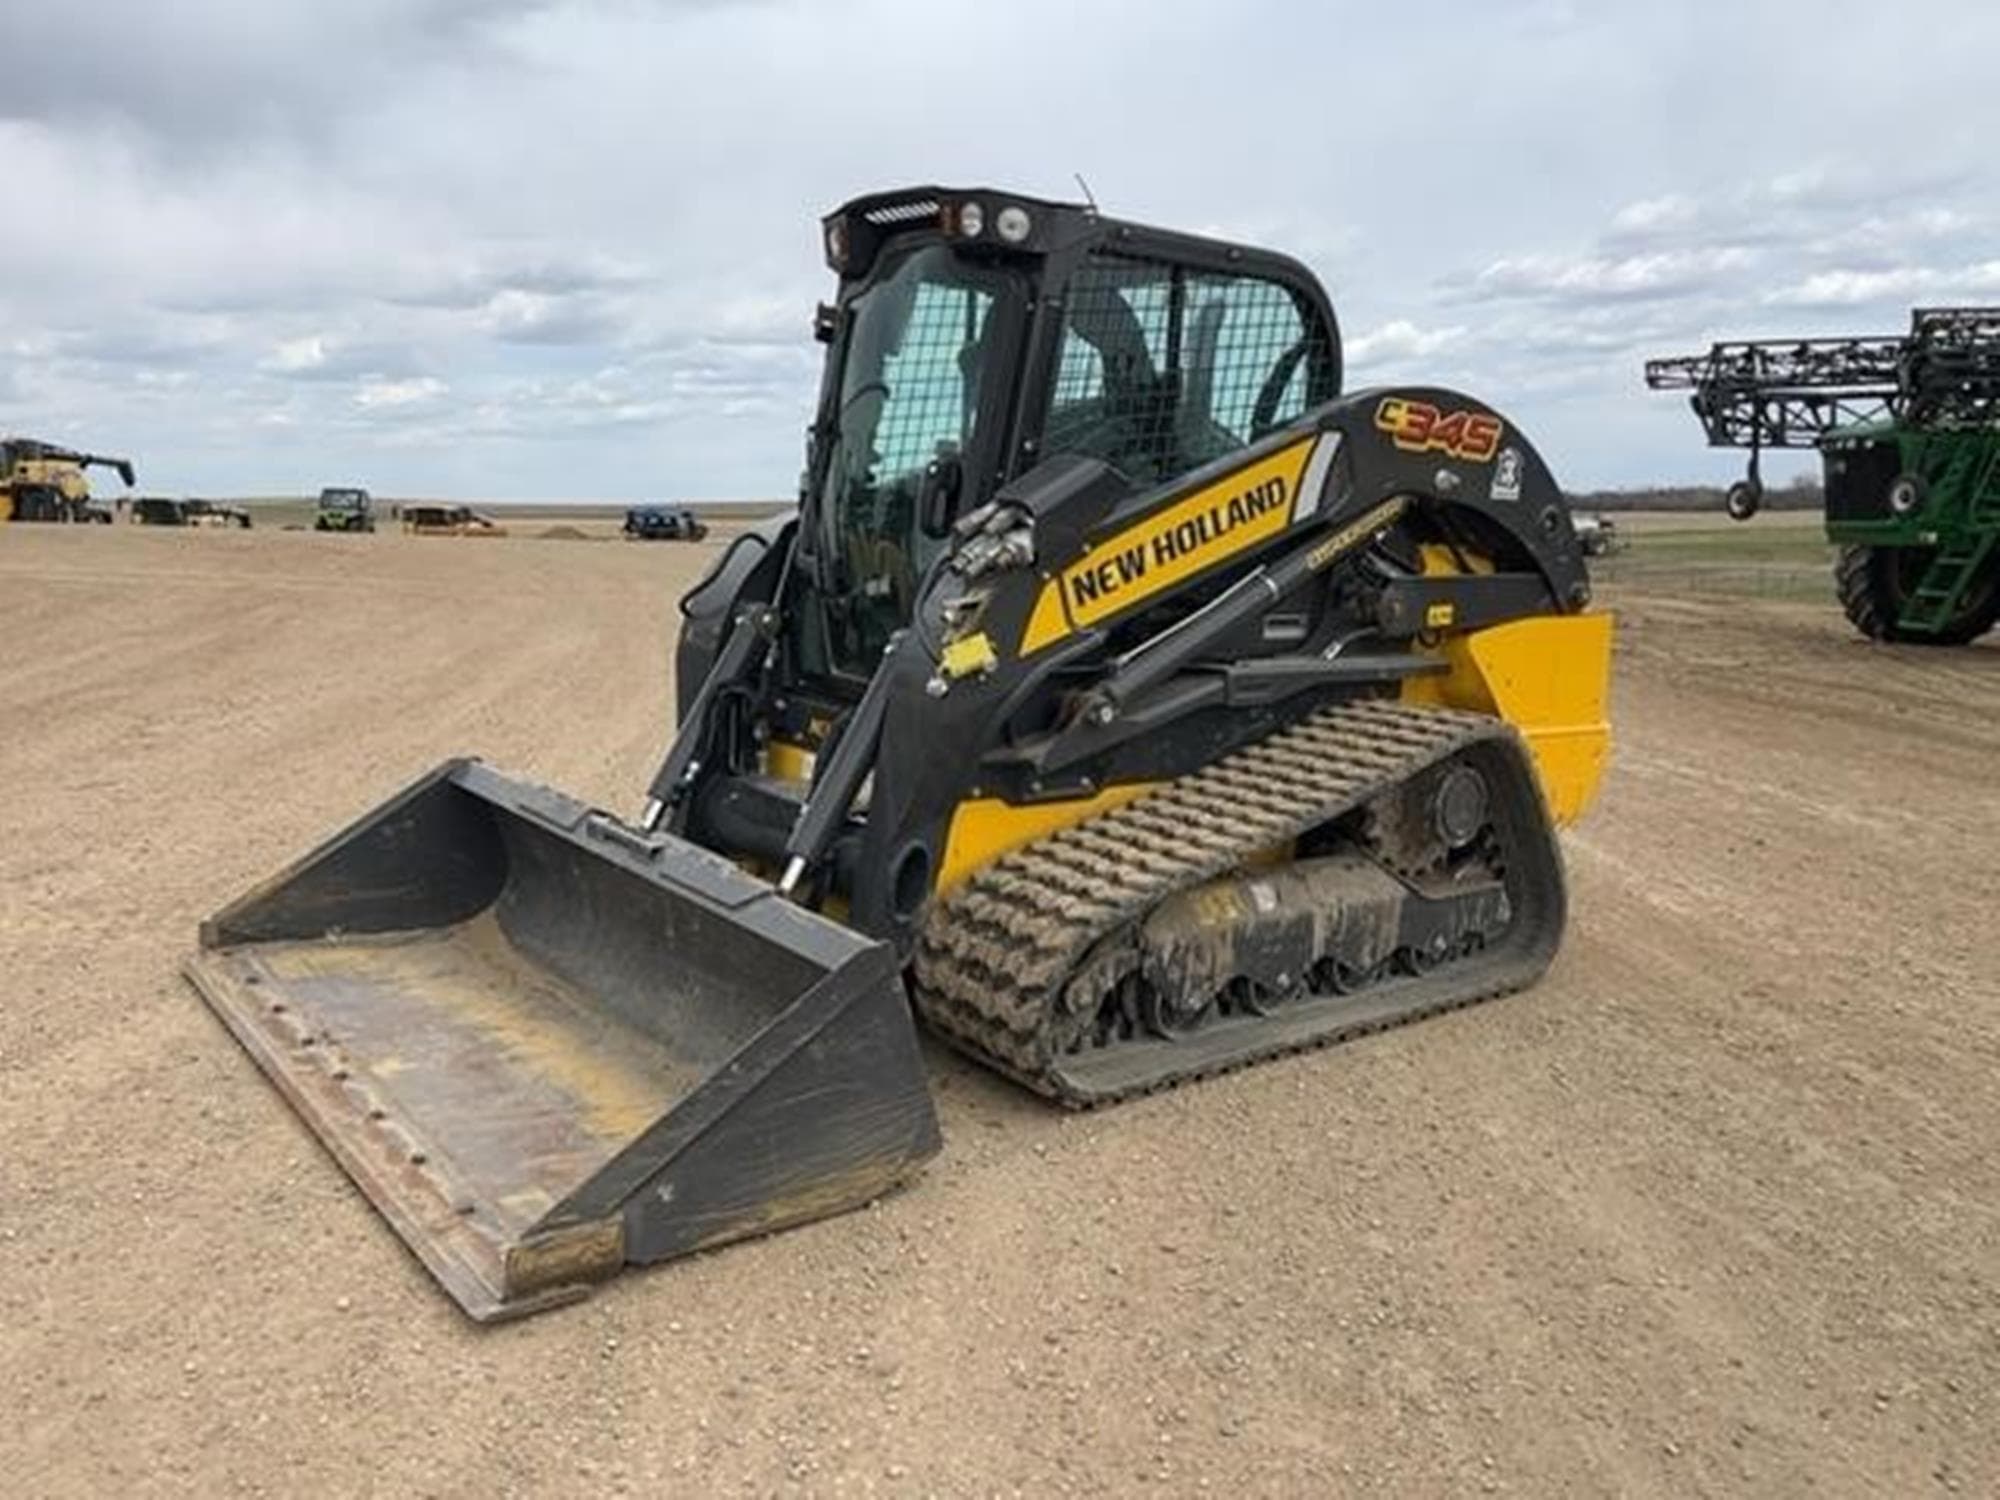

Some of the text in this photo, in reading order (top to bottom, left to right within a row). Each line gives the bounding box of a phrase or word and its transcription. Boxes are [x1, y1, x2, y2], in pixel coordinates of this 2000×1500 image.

[1375, 397, 1503, 462] C345
[1072, 544, 1146, 607] NEW
[1152, 476, 1286, 567] HOLLAND
